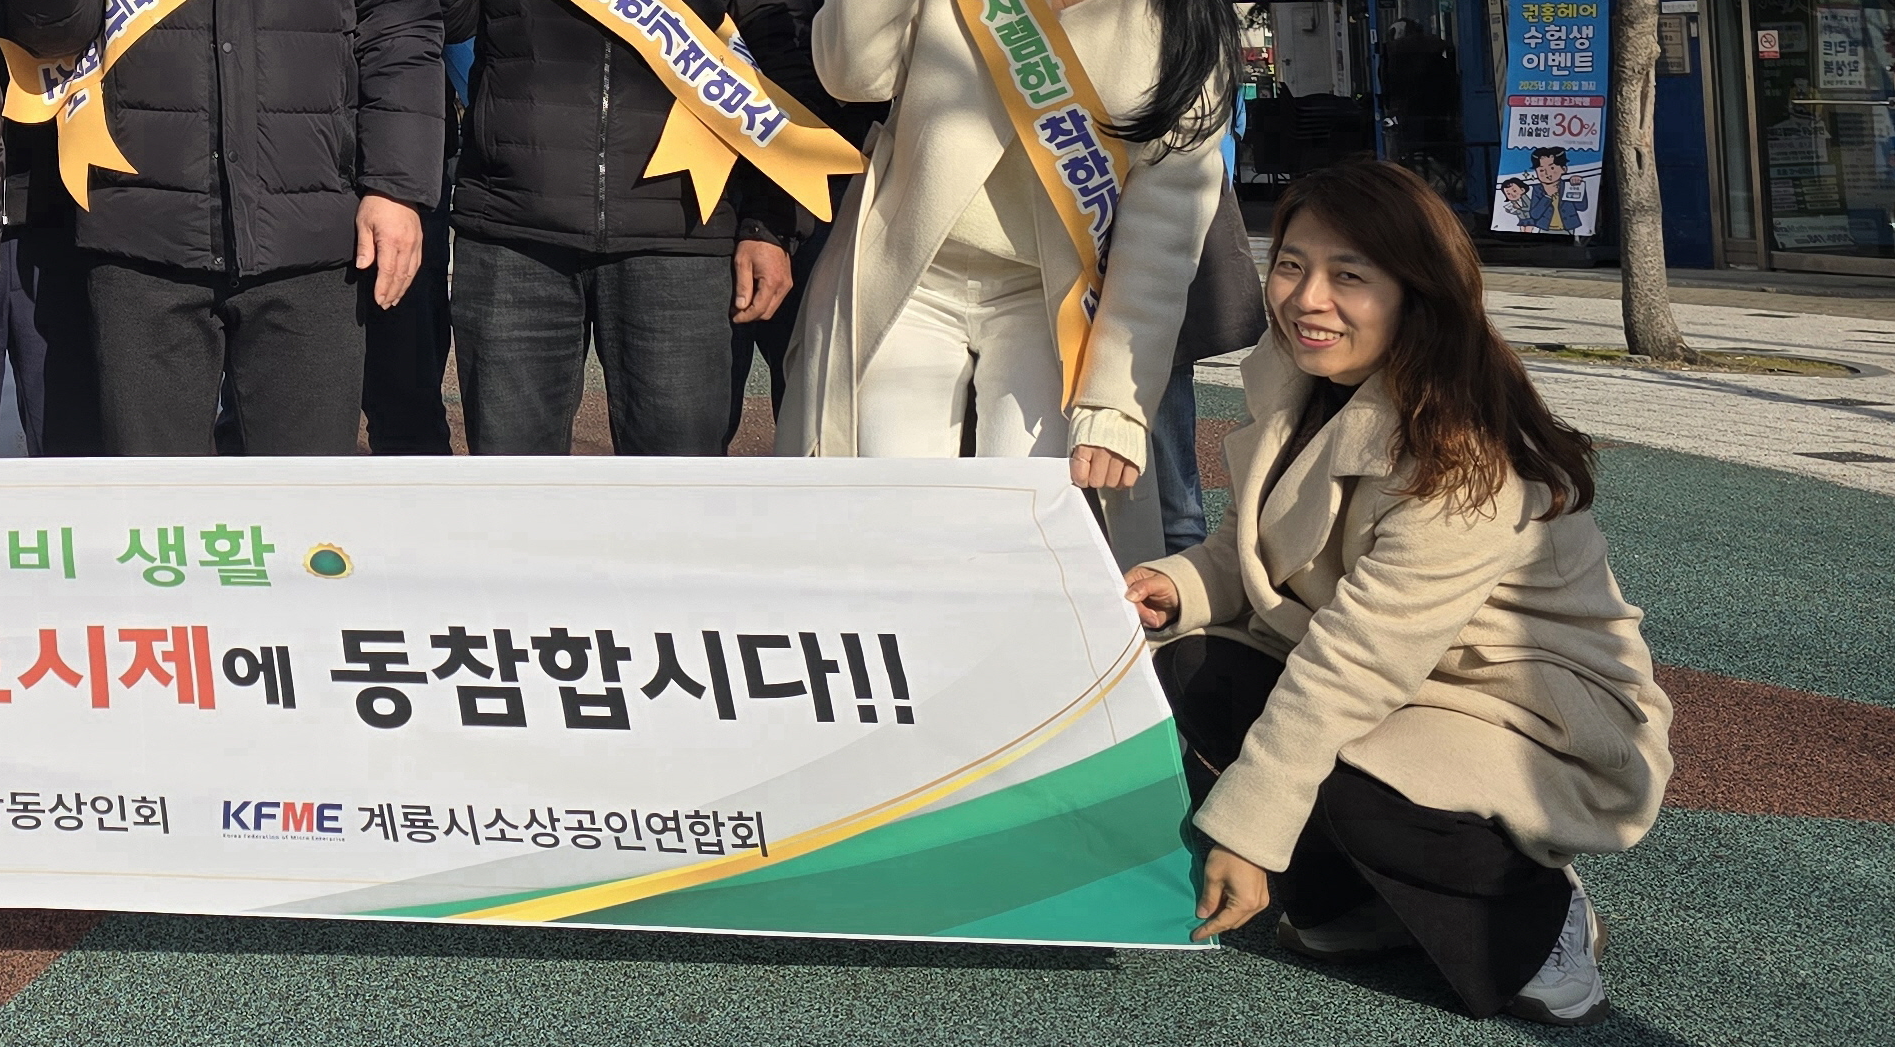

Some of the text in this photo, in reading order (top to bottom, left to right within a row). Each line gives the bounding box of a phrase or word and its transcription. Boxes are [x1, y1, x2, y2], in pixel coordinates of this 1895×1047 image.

[1522, 3, 1597, 23] 권홍헤어
[1523, 25, 1594, 49] 수험생
[1522, 52, 1592, 76] 이벤트
[1552, 113, 1597, 137] 30%
[117, 523, 275, 588] 생활
[330, 626, 915, 729] 동참합시다!!
[222, 800, 343, 834] KFME
[358, 802, 770, 858] 계룡시소상공인연합회
